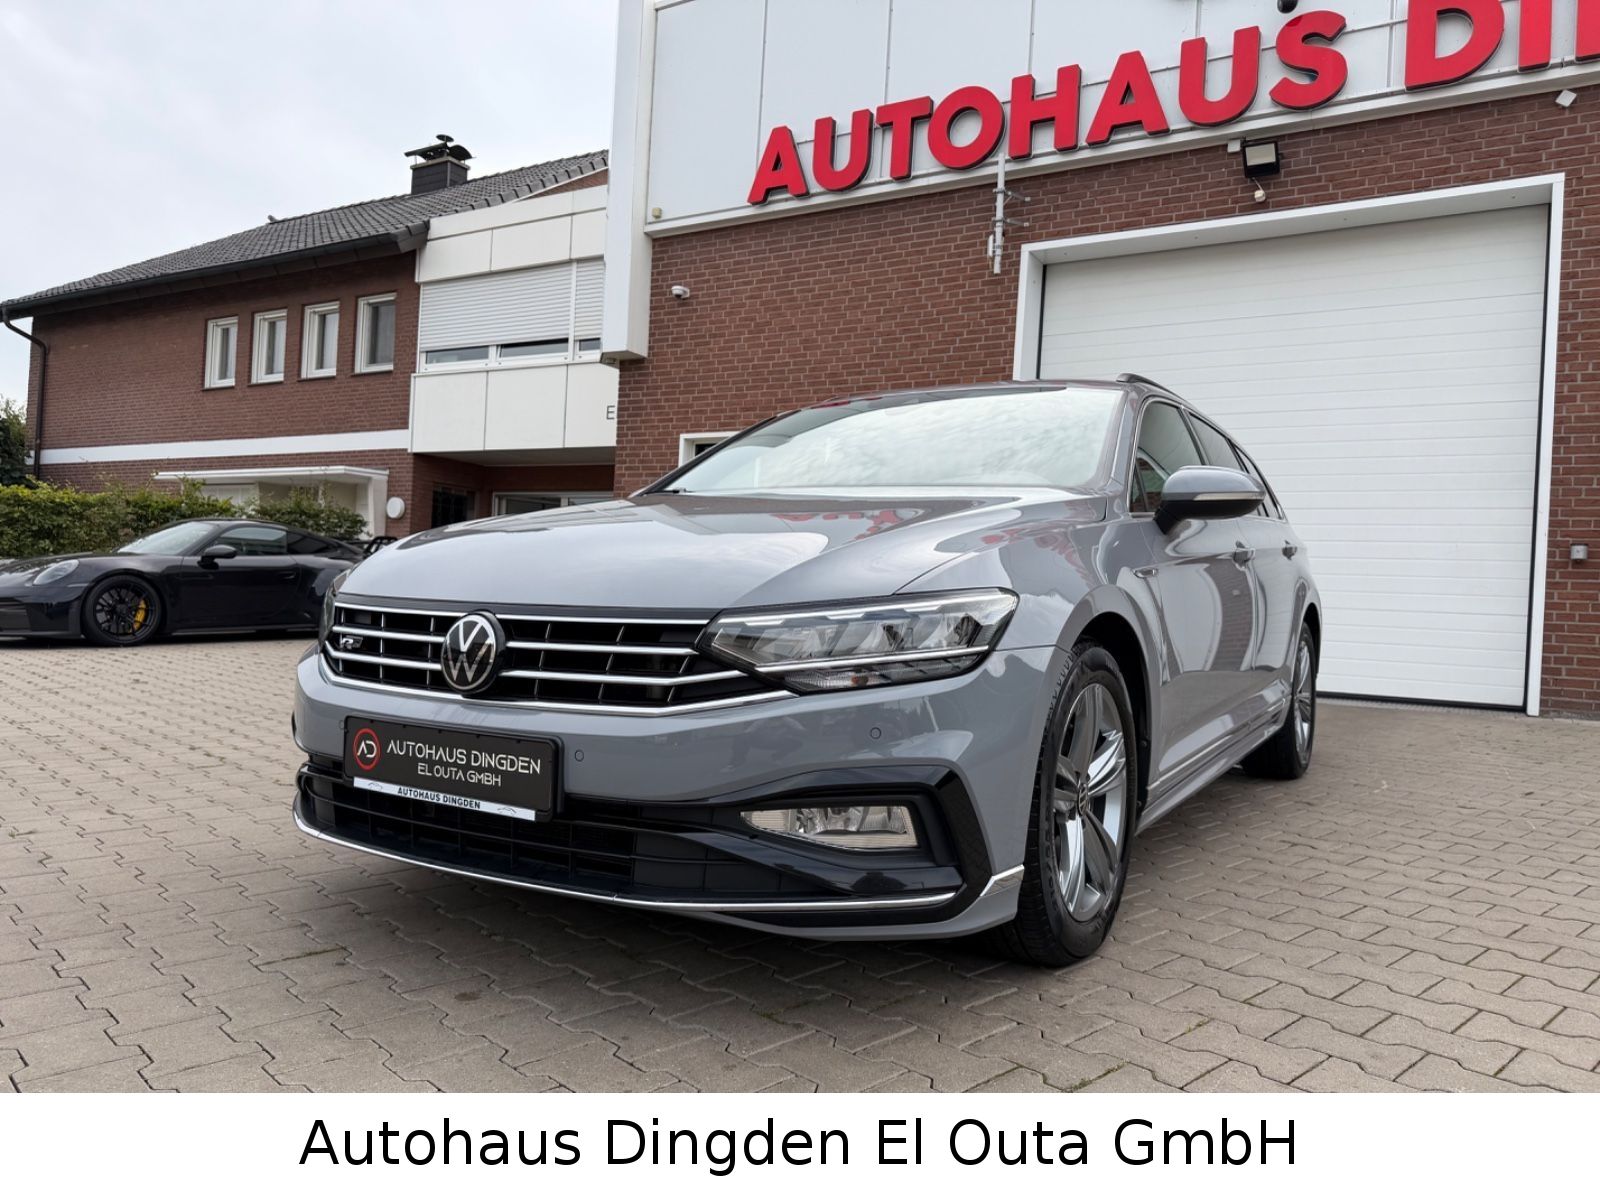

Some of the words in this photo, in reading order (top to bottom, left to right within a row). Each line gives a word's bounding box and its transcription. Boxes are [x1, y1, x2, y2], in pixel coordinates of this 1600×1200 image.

[747, 10, 1350, 206] AUTOHAUS
[1404, 0, 1600, 91] DI
[386, 739, 467, 765] AUTOHAUS
[471, 750, 541, 775] DINGDEN
[417, 762, 432, 776] EL
[433, 764, 465, 781] OUTA
[466, 770, 501, 787] GMBH
[397, 786, 441, 802] AUTOHAUS
[442, 794, 481, 810] DINGDEN
